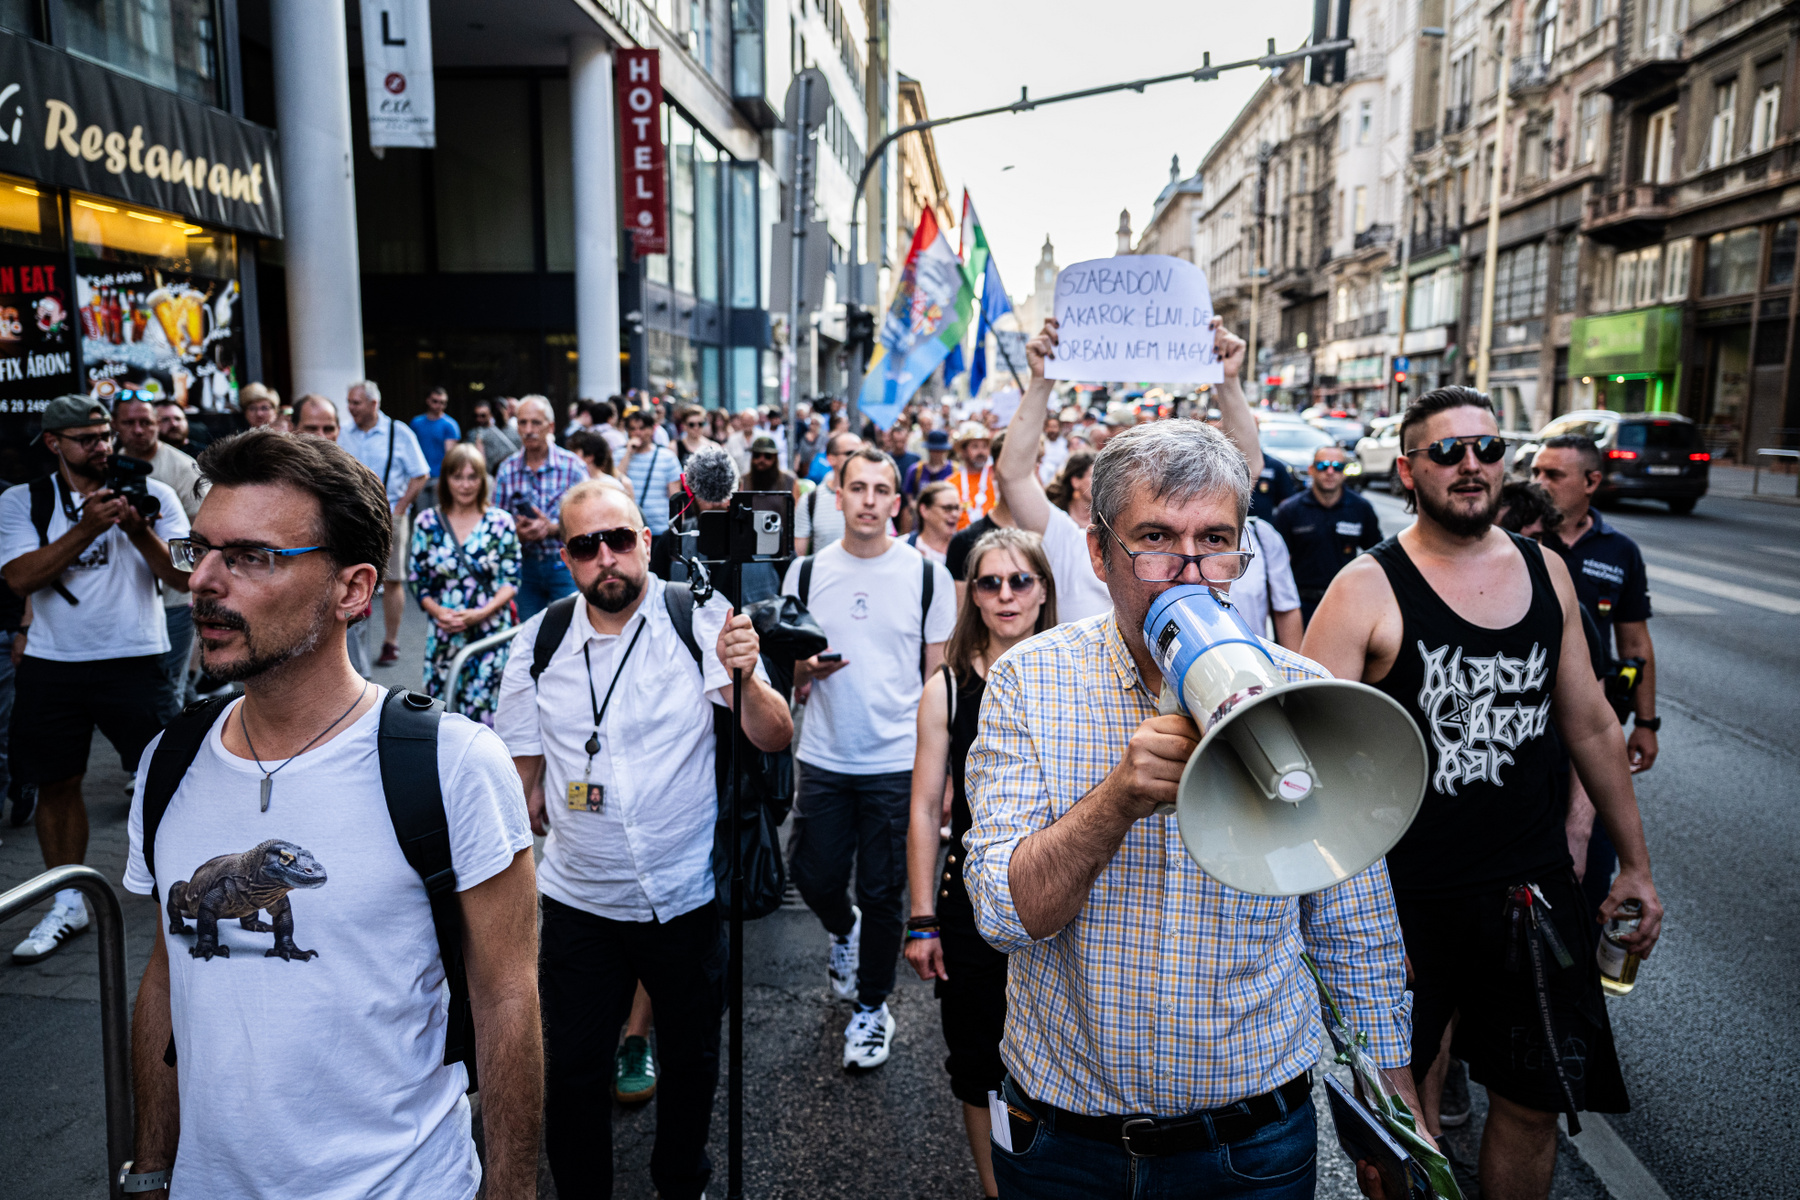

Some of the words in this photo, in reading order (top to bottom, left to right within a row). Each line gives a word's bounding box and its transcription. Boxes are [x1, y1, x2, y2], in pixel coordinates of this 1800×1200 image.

[628, 57, 653, 199] HOTEL
[45, 99, 263, 205] Restaurant
[20, 265, 56, 293] EAT
[1059, 267, 1173, 297] SZABADON
[1061, 304, 1135, 328] AKAROK
[1193, 307, 1211, 328] DE
[1058, 335, 1118, 362] ORBÁN
[1125, 340, 1160, 361] NEM
[0, 357, 24, 382] FIX
[27, 349, 72, 380] ÁRON!
[11, 399, 25, 413] 20
